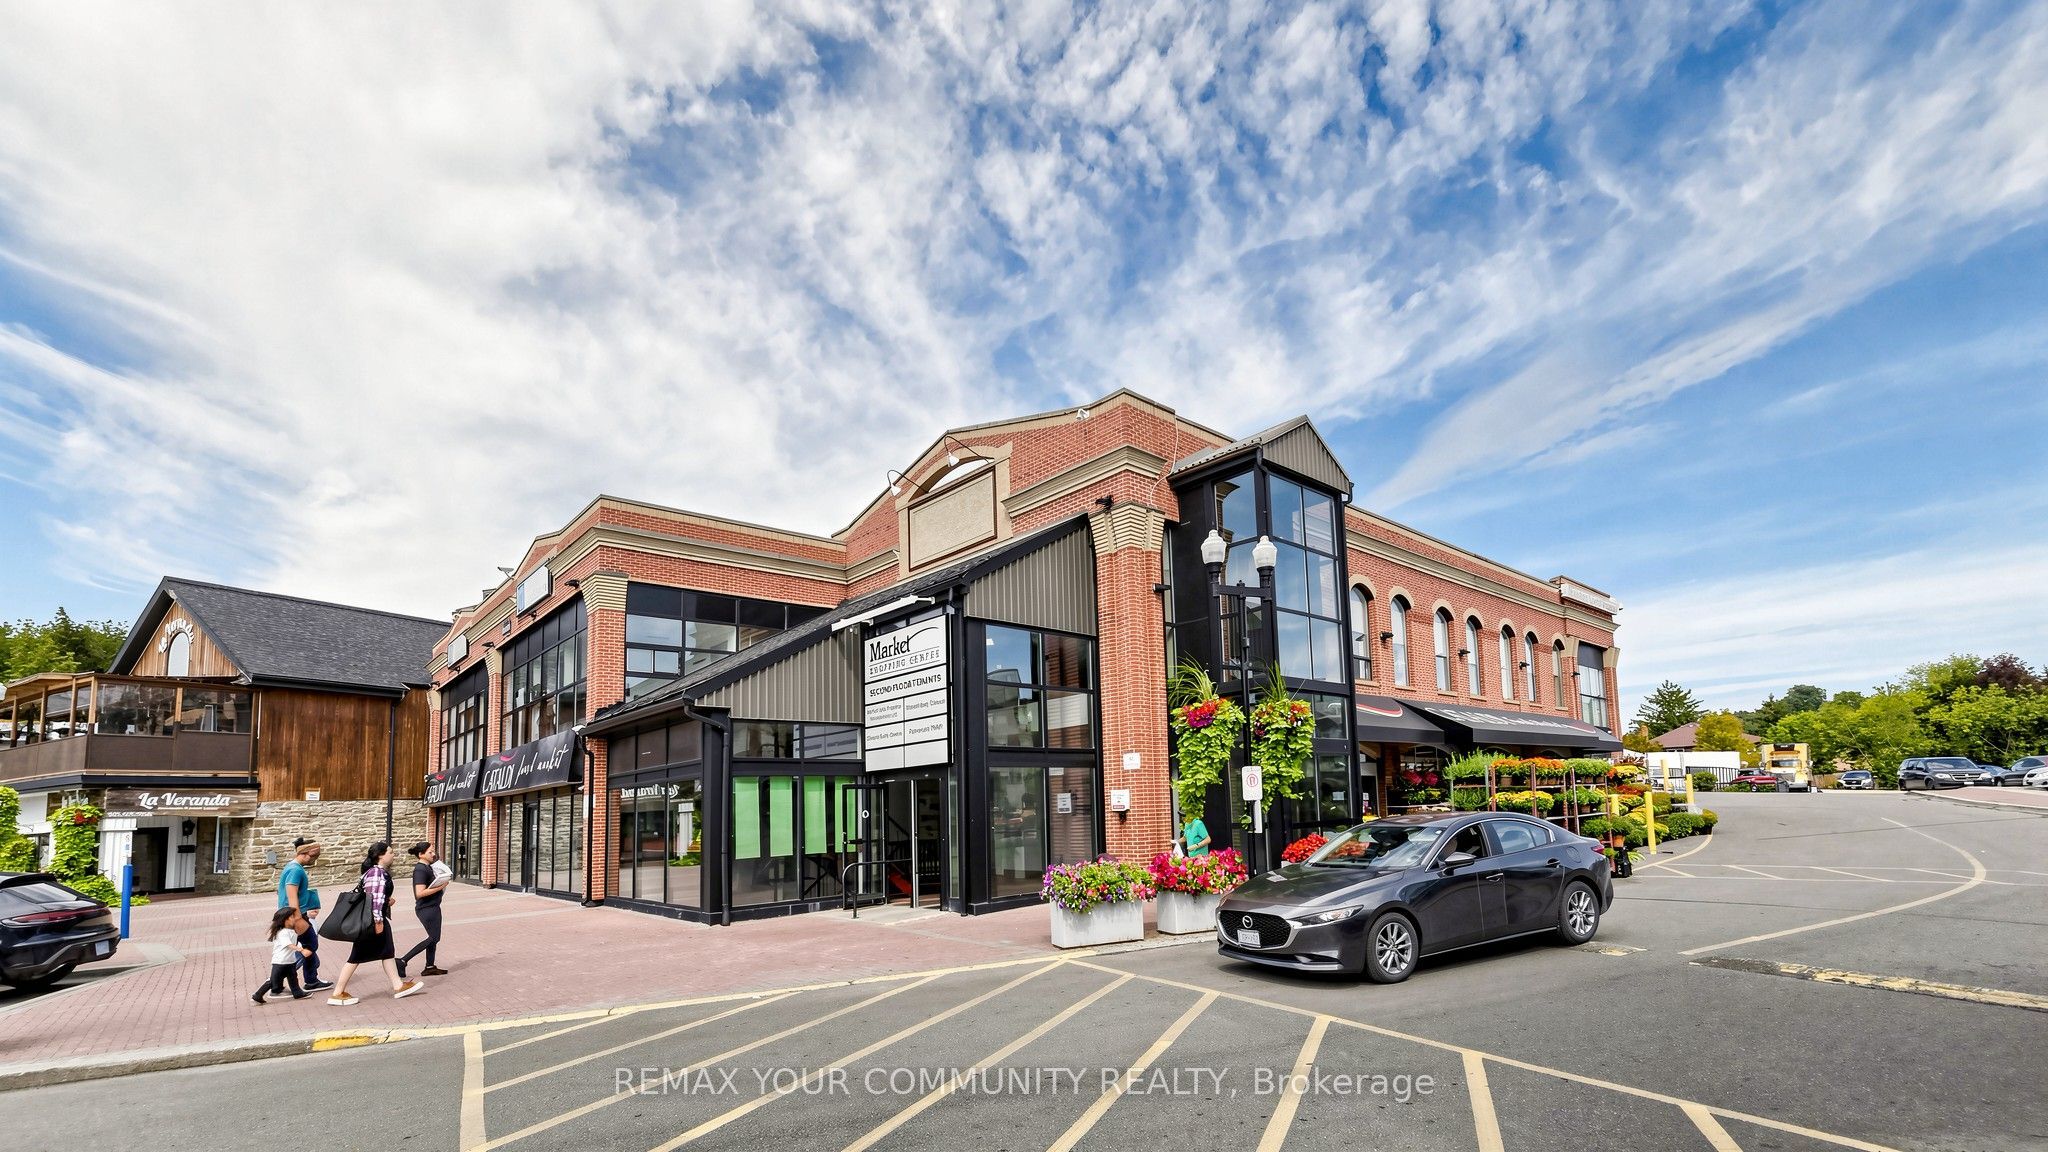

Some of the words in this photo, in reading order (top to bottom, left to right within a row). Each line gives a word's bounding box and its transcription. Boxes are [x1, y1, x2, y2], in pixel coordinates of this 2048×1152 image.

[870, 633, 916, 662] Market
[138, 793, 159, 809] La
[161, 793, 231, 806] Veranda
